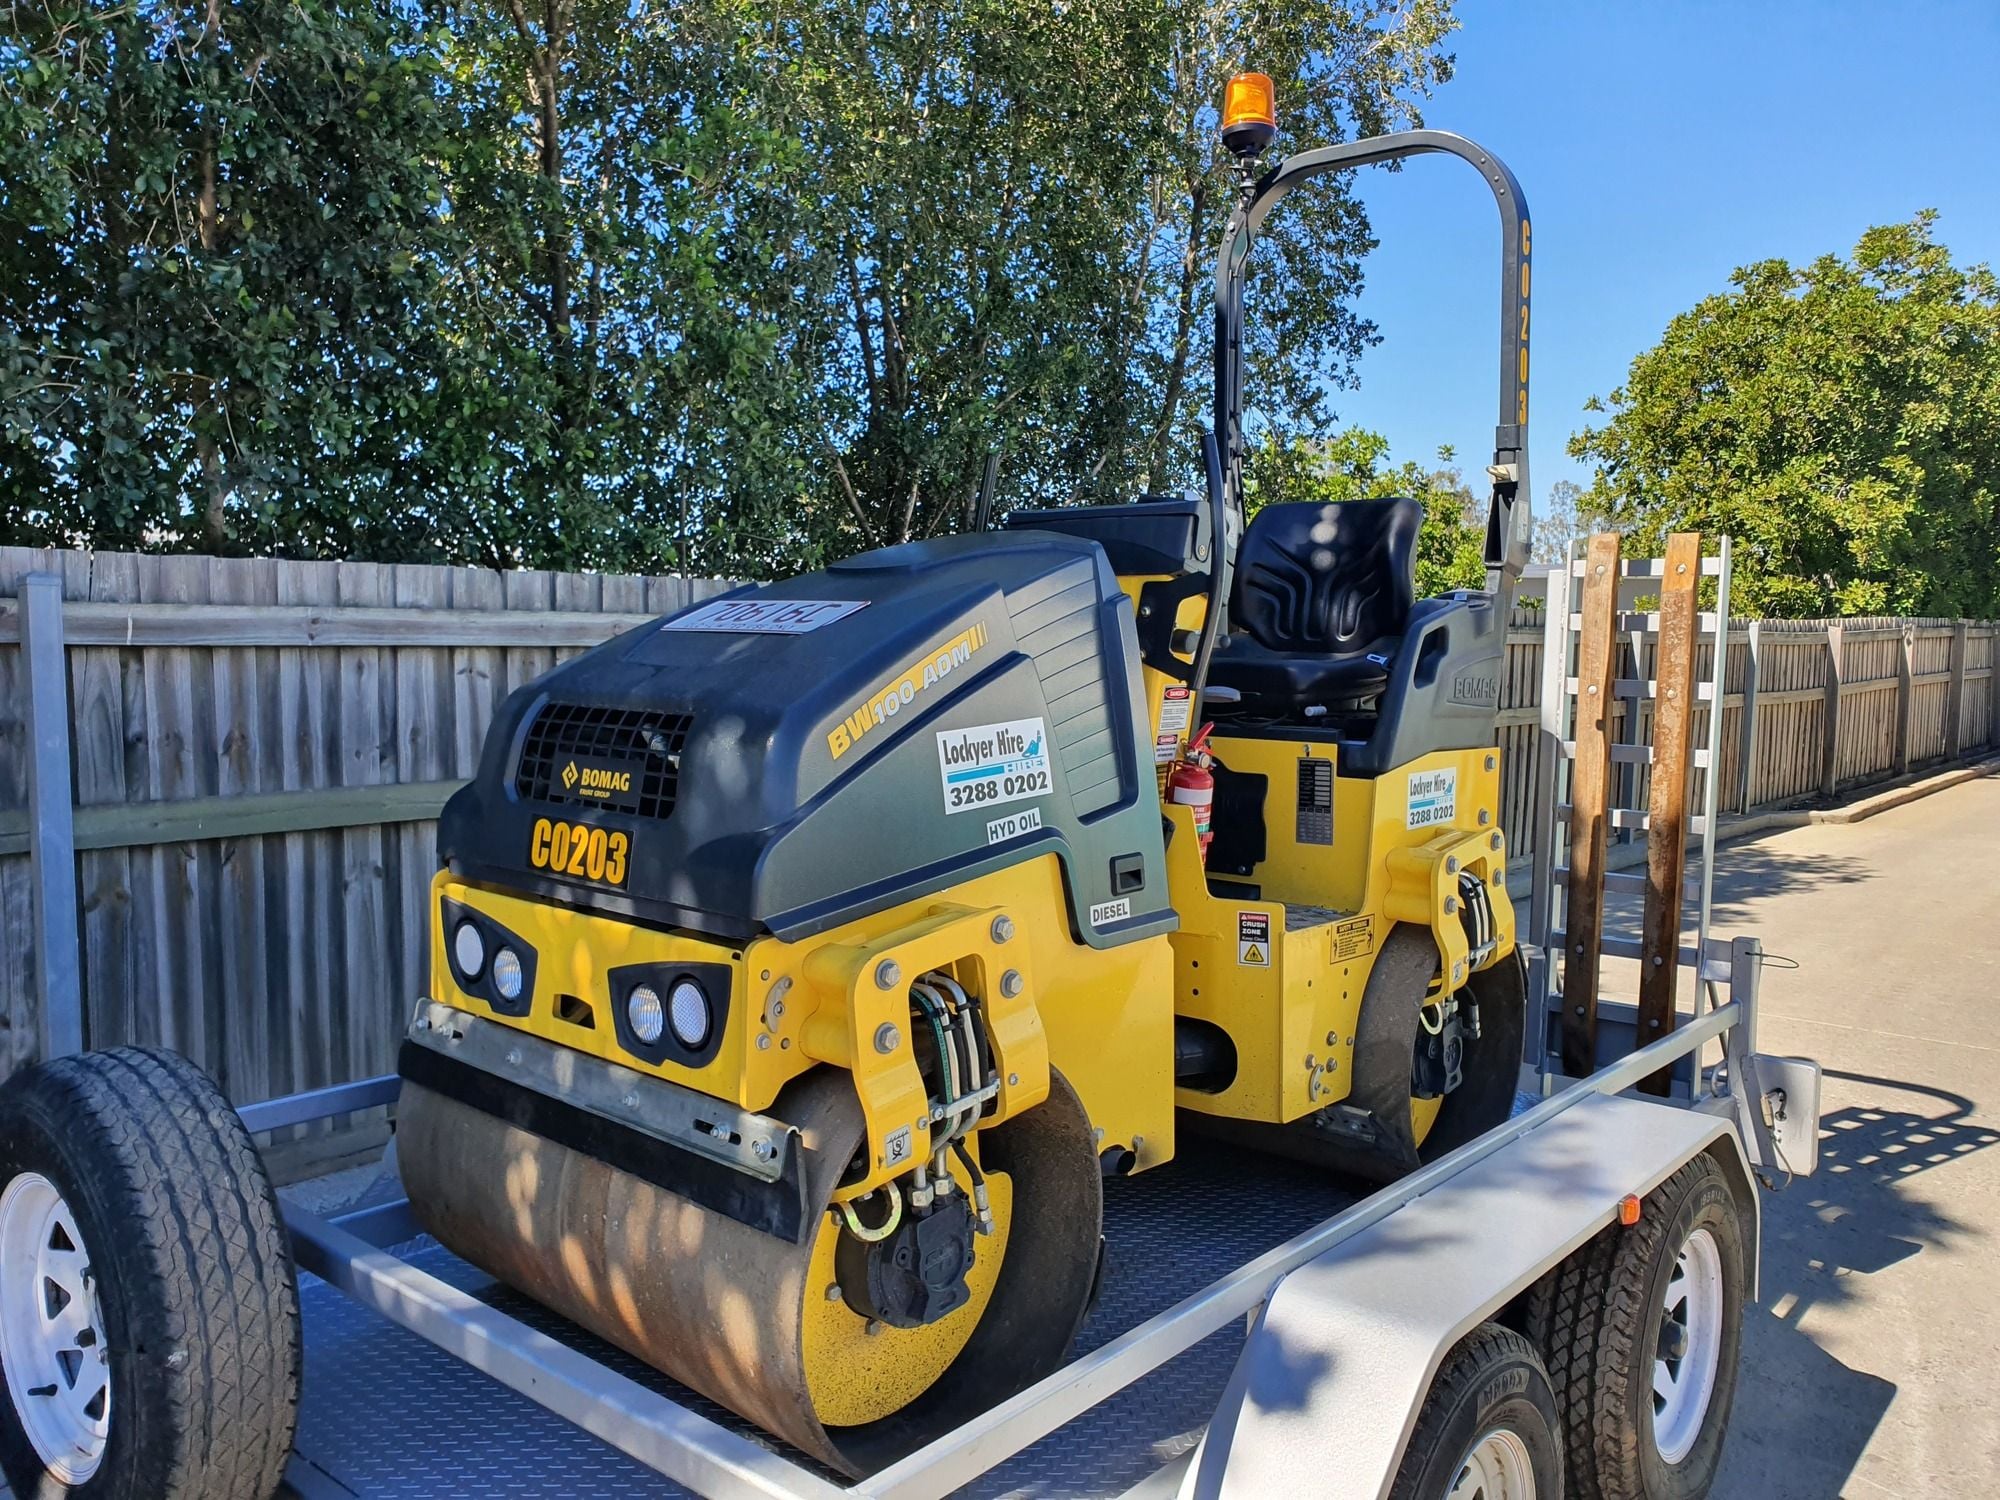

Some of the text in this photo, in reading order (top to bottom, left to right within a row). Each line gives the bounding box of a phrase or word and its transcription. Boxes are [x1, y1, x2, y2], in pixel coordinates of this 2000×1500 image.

[922, 641, 972, 690] ADM
[1453, 677, 1496, 699] BOMAG
[942, 728, 1024, 766] Lockyer Hire
[581, 768, 632, 792] BOMAG
[950, 771, 1048, 806] 3288 0202
[1410, 773, 1446, 798] Lockyer Hire
[990, 812, 1040, 840] HYD OIL
[1410, 805, 1454, 825] 3288 0202
[1092, 903, 1128, 923] DIESEL
